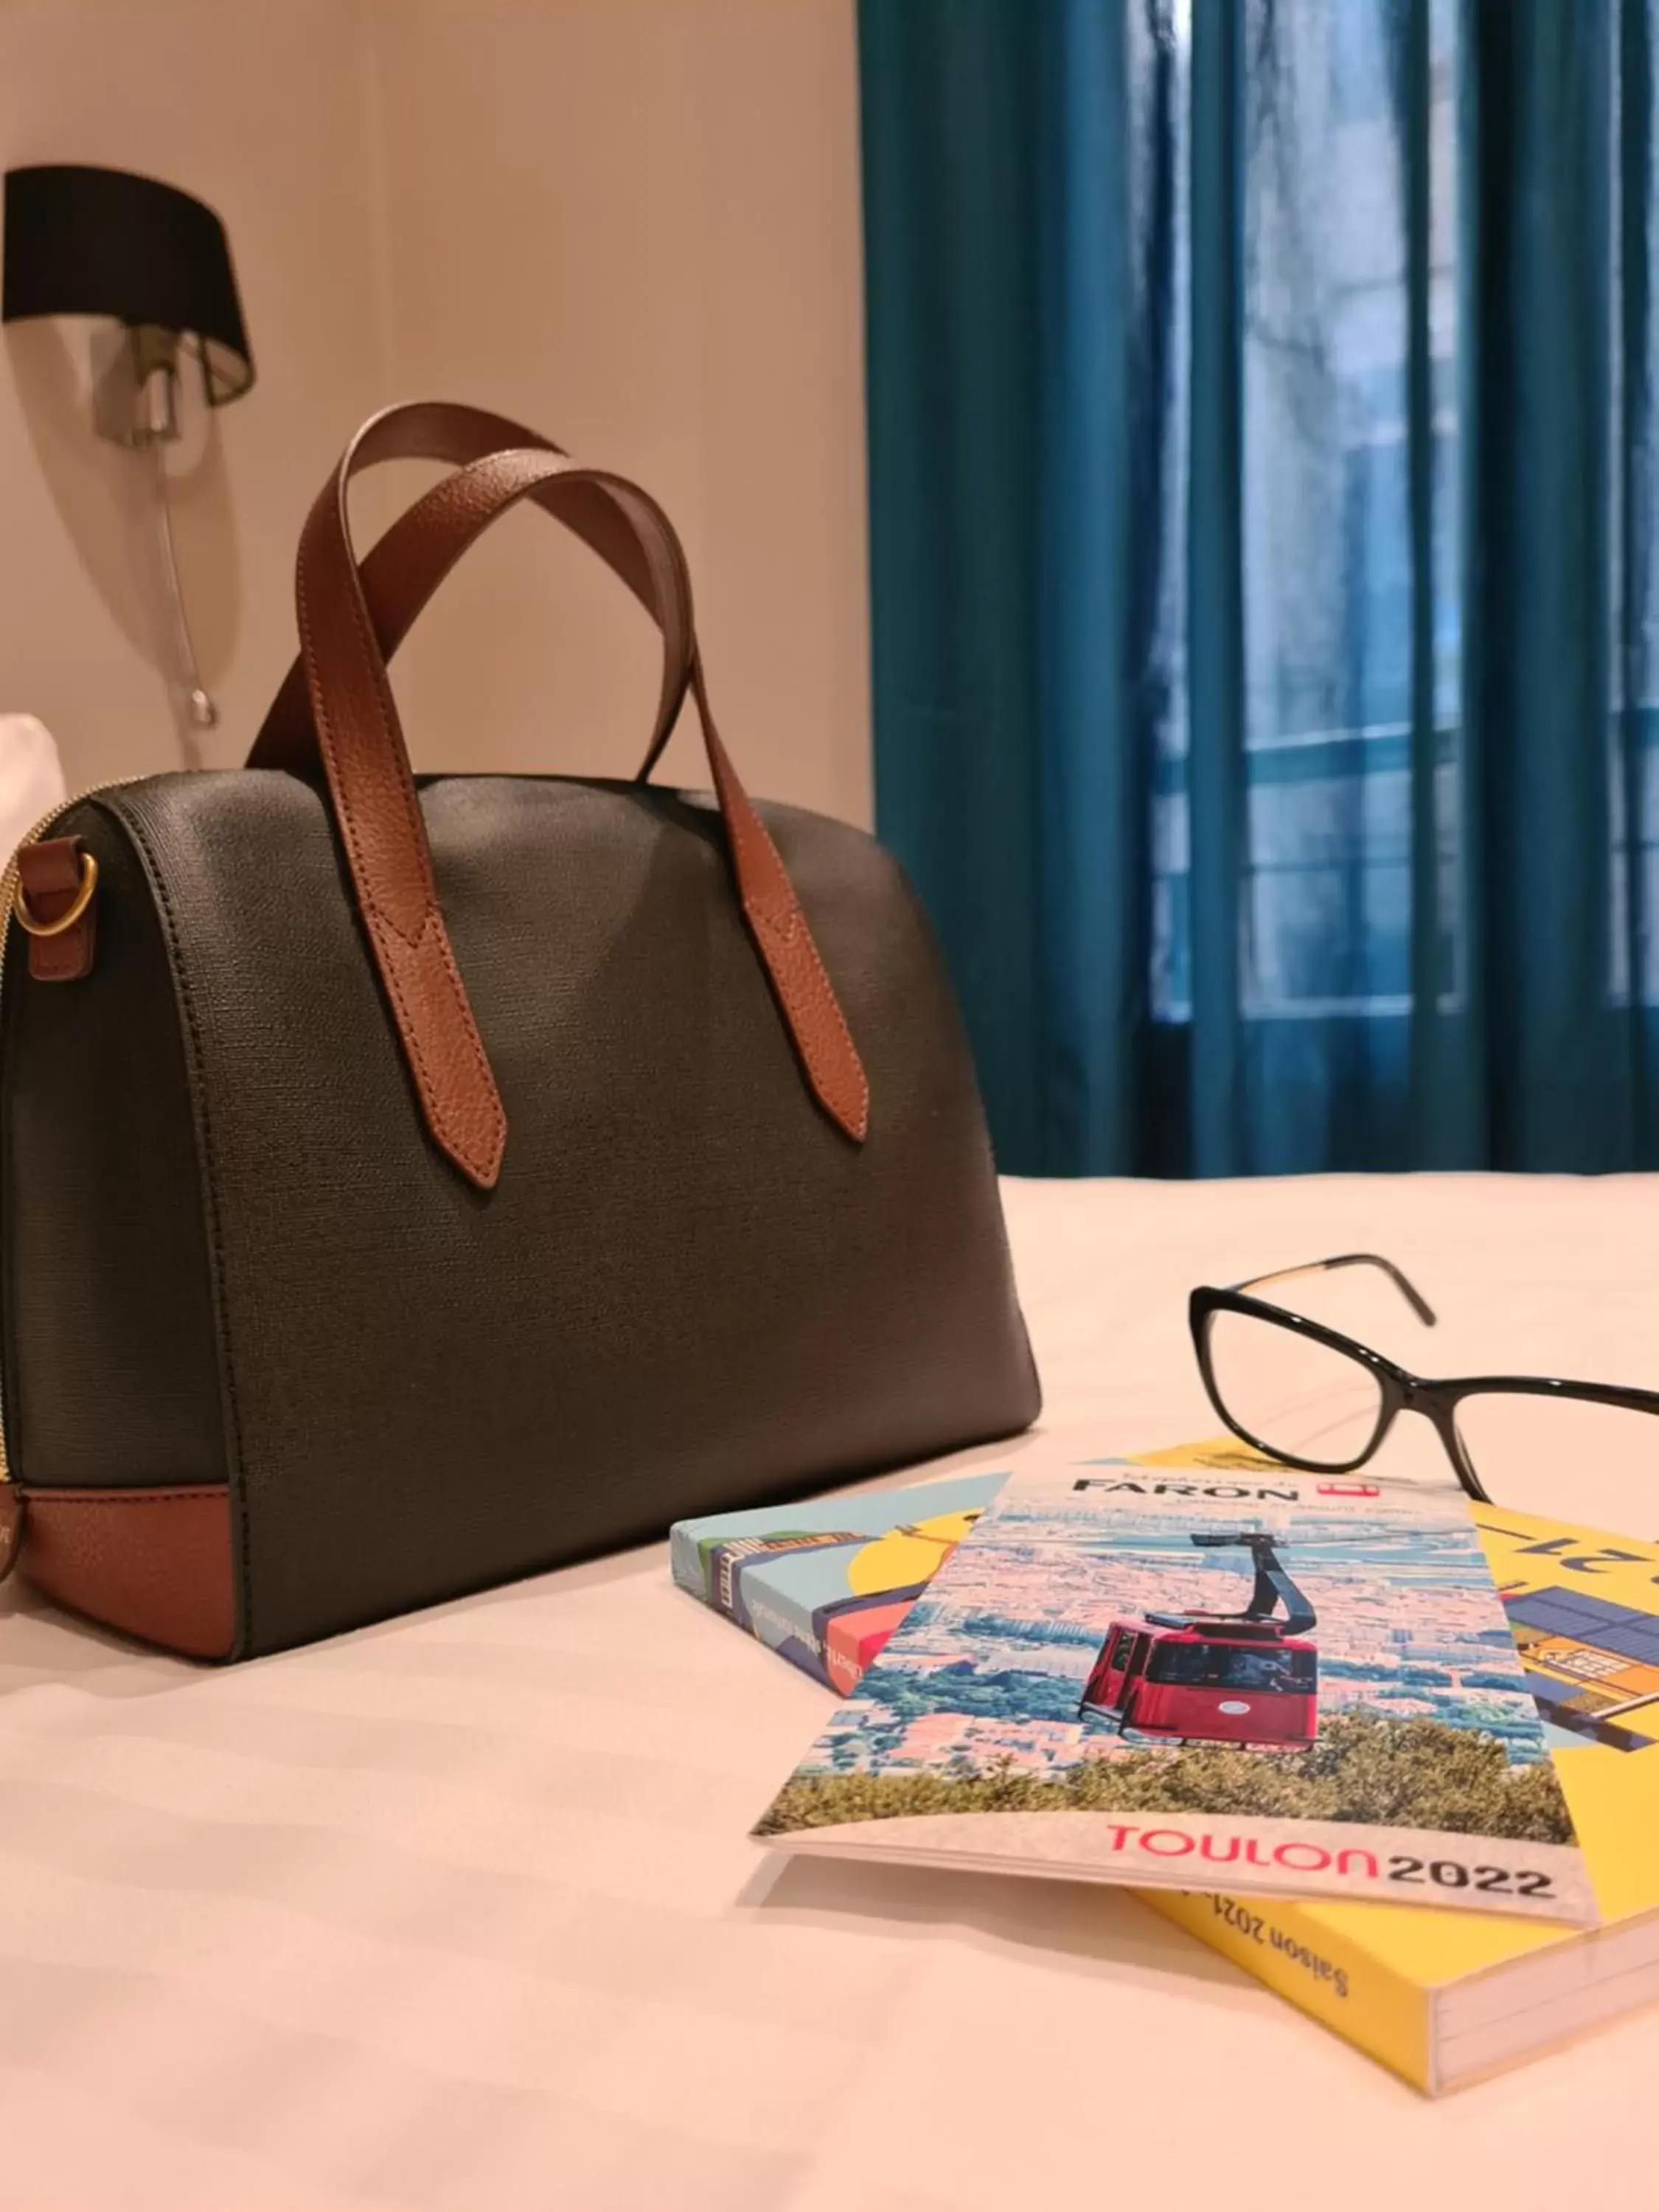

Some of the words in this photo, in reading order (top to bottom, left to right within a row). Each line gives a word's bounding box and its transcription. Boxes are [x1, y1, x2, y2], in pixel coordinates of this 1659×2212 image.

[1072, 1478, 1300, 1502] FARON
[1387, 1854, 1558, 1900] 2022
[1268, 1927, 1349, 1999] Saison
